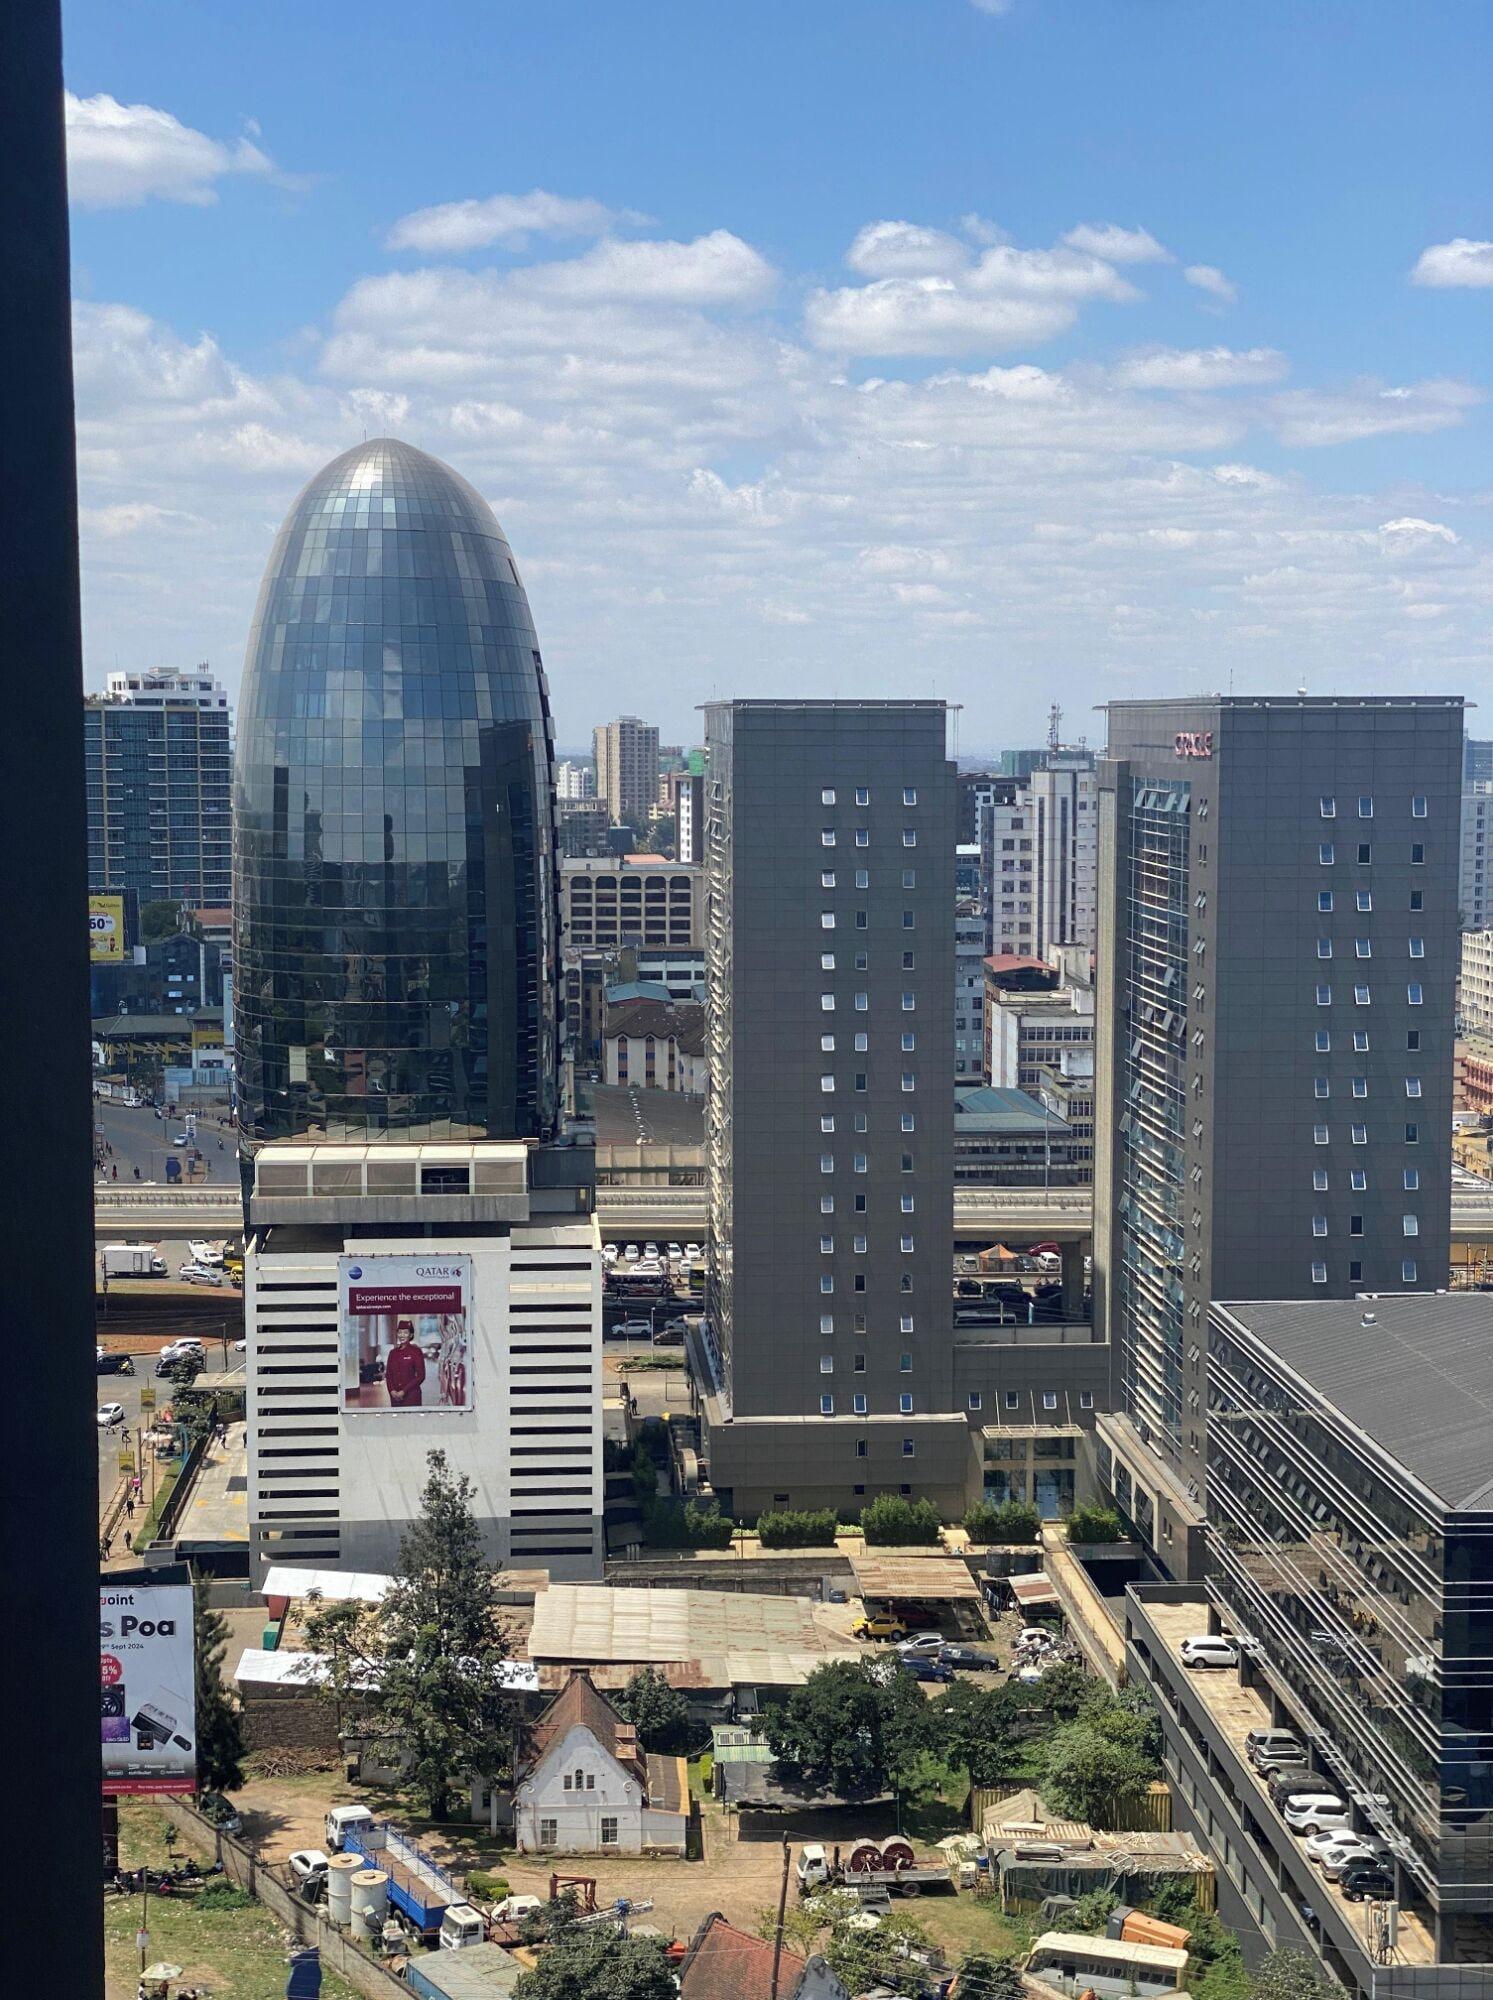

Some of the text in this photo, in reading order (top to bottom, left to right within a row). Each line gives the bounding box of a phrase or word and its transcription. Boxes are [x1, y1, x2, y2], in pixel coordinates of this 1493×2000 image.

[416, 1267, 449, 1277] QATAR
[356, 1292, 455, 1302] Experience the exceptional
[121, 1615, 176, 1637] Poa
